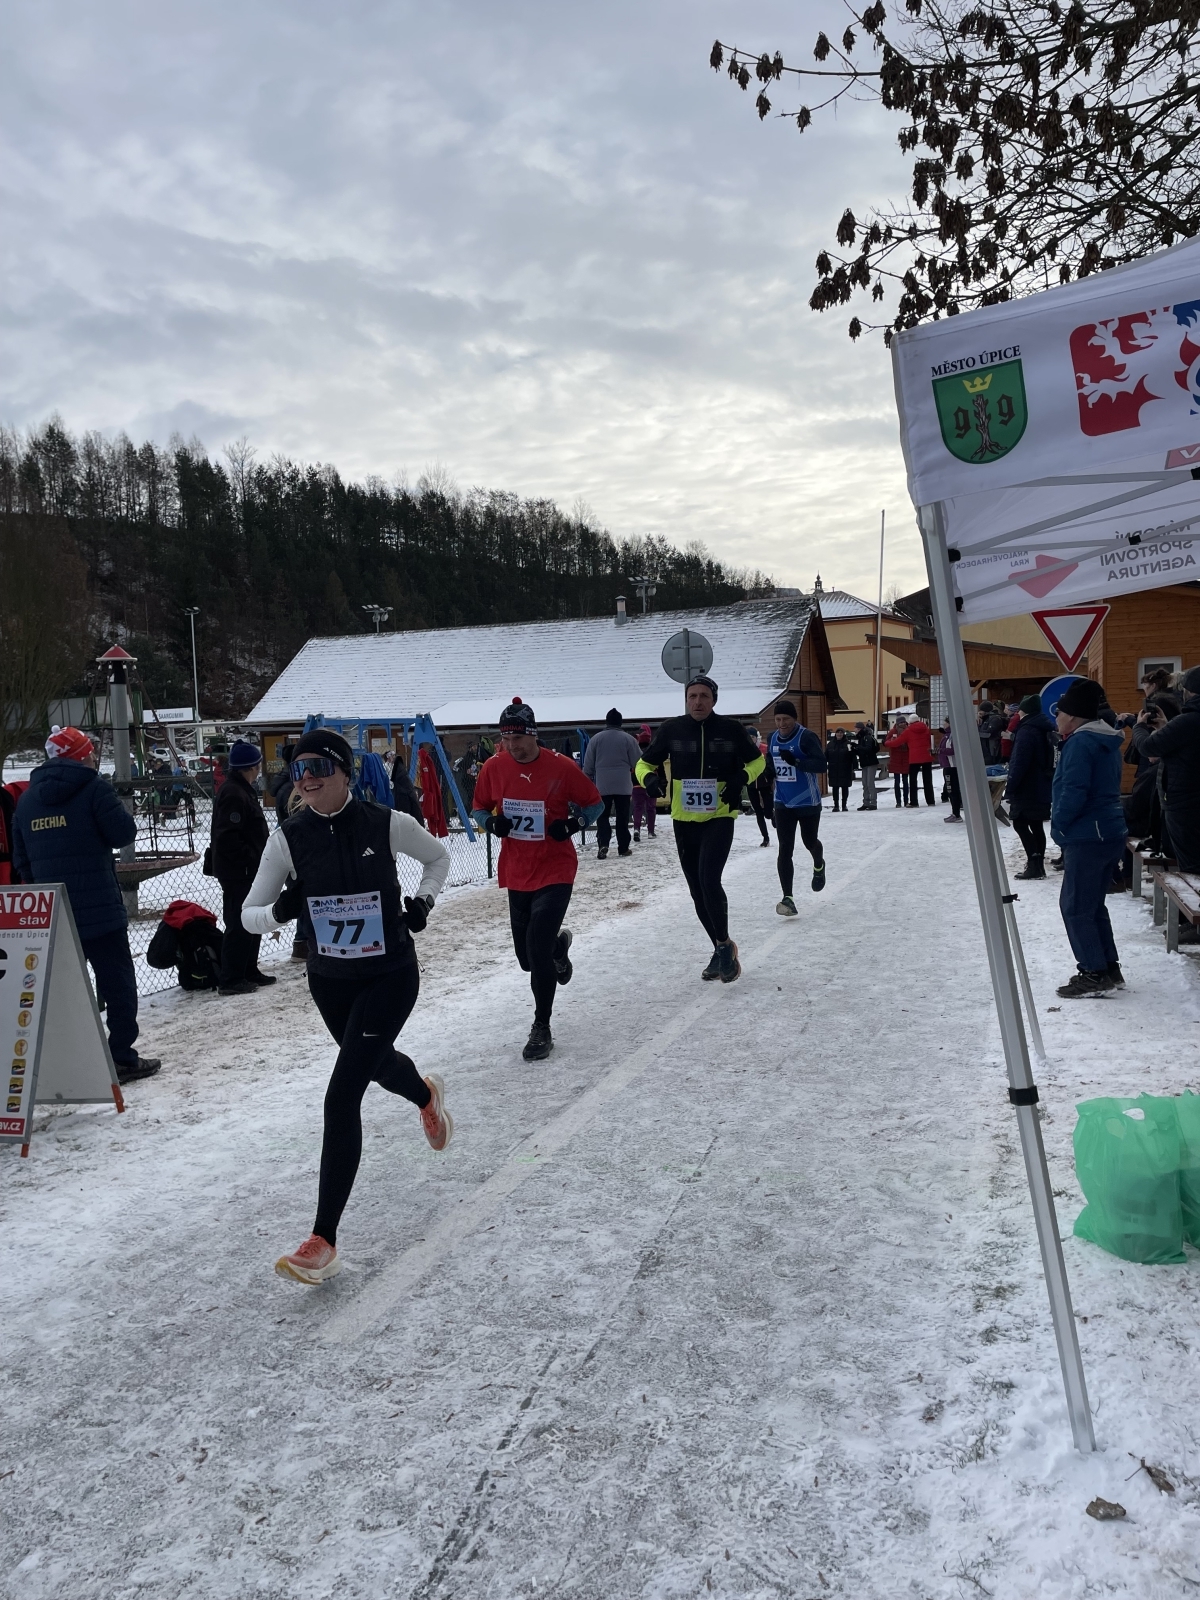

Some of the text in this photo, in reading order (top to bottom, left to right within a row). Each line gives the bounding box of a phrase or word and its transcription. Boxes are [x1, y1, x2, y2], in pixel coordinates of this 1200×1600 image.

[931, 345, 1021, 377] MĚSTO ÚPICE
[776, 766, 793, 777] 221
[686, 792, 713, 806] 319
[31, 815, 67, 832] CZECHIA
[512, 816, 535, 832] 72
[356, 903, 379, 911] LIGA
[19, 915, 47, 925] stav
[328, 918, 365, 944] 77
